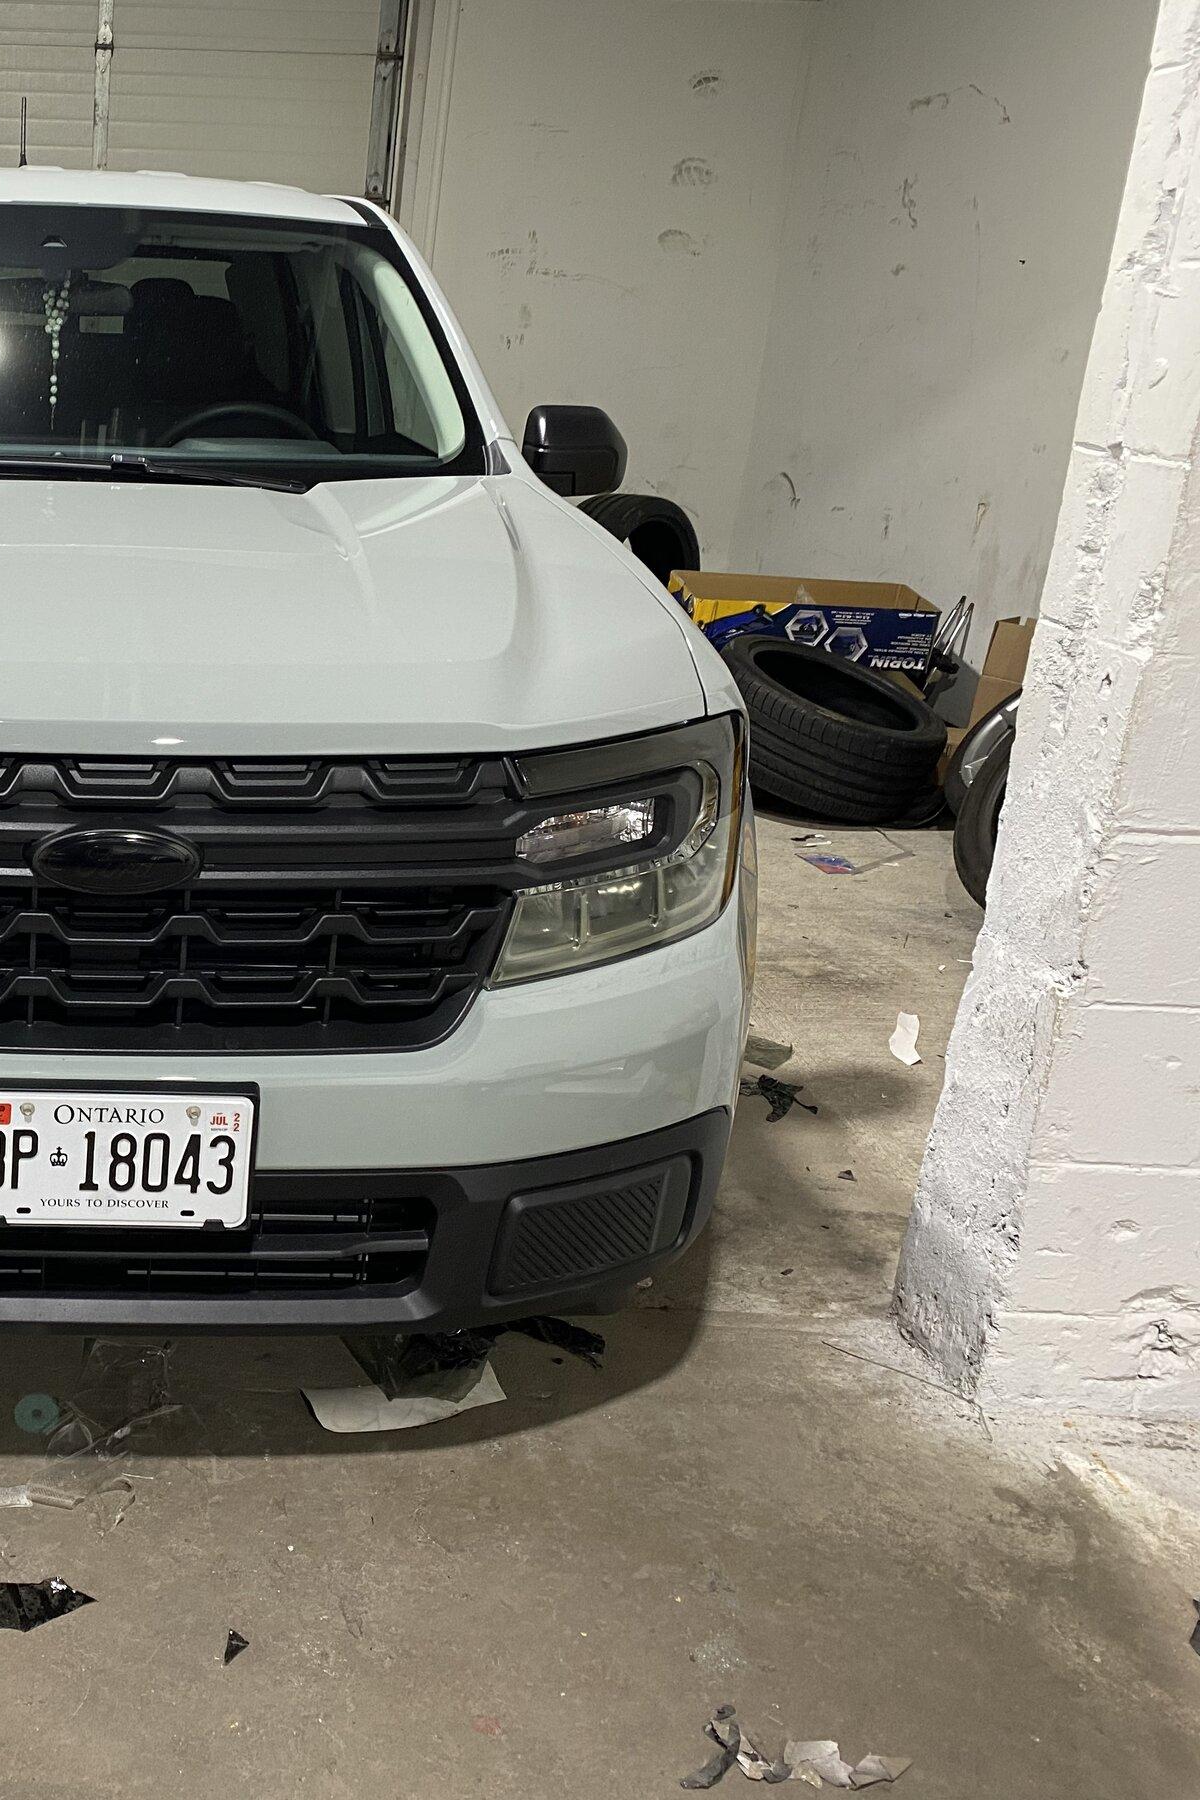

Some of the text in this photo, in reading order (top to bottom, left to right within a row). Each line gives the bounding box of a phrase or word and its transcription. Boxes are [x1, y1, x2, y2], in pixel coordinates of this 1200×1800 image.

[870, 655, 925, 670] TORIN
[53, 1104, 165, 1126] ONTARIO
[209, 1115, 229, 1126] JUL
[78, 1130, 236, 1196] 18043
[40, 1198, 169, 1209] YOURS TO DISCOVER
